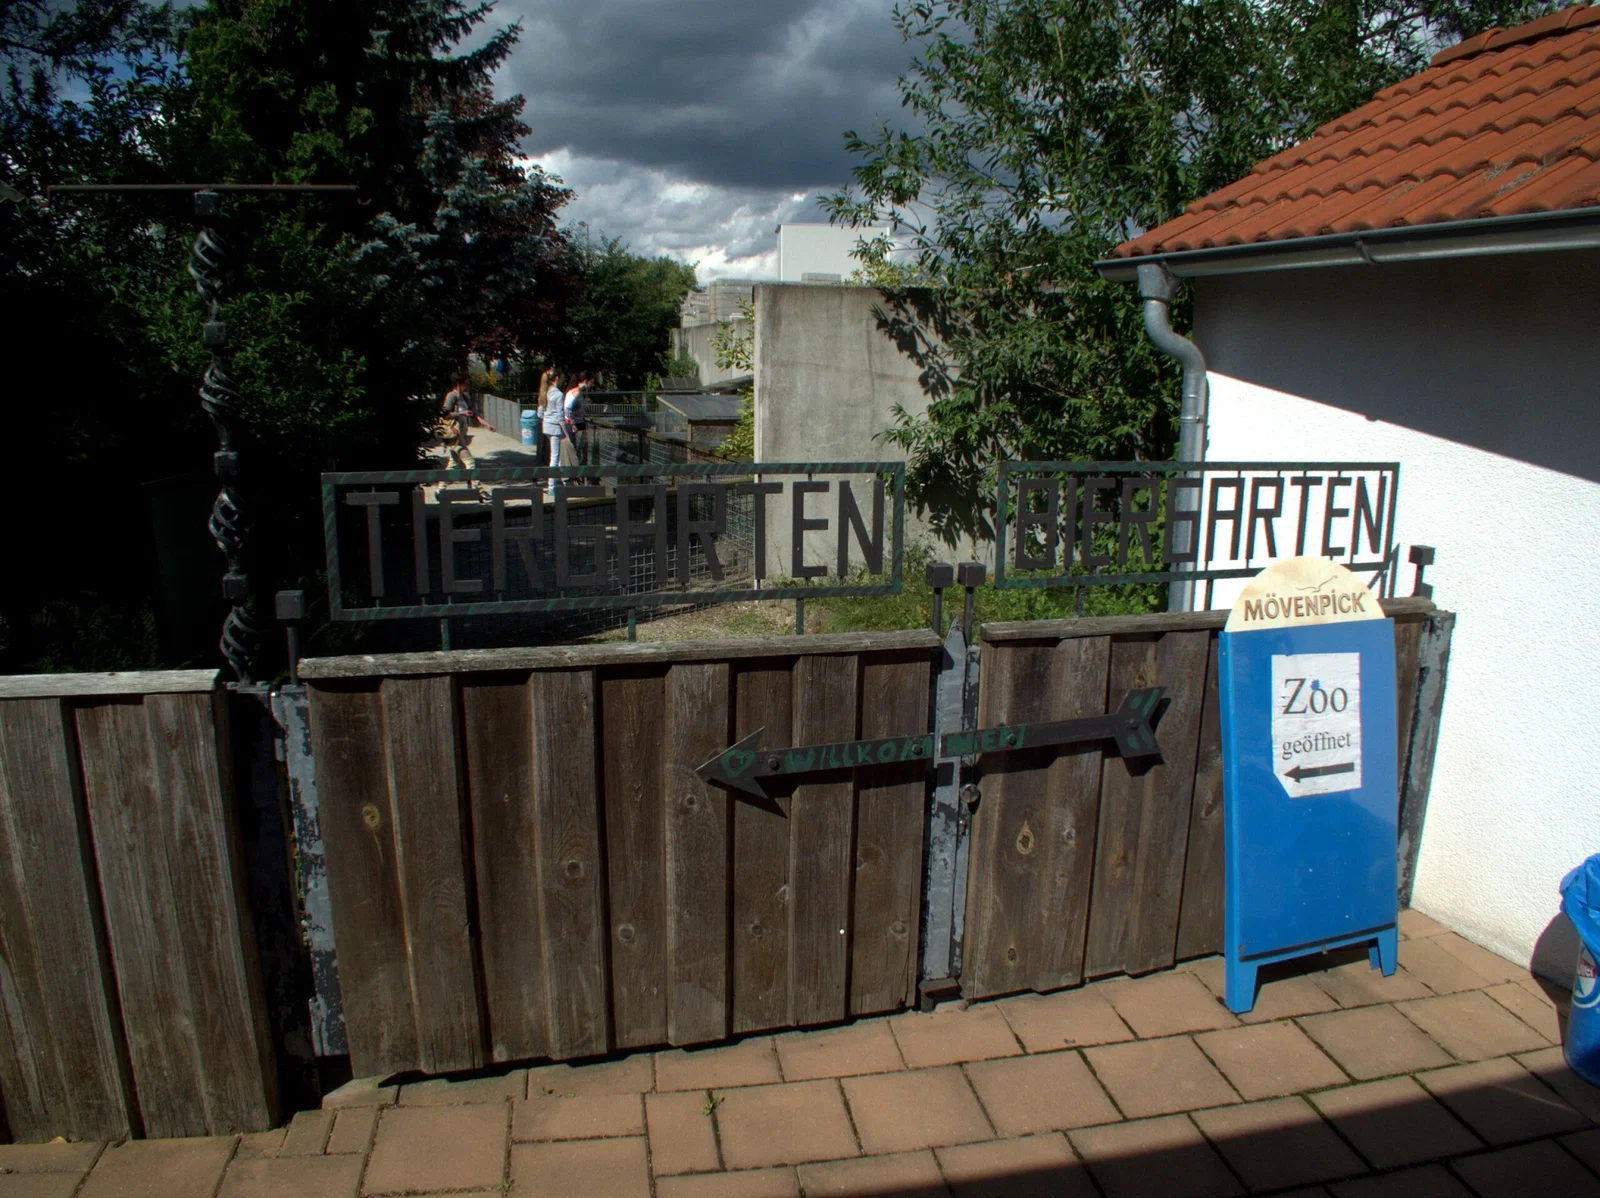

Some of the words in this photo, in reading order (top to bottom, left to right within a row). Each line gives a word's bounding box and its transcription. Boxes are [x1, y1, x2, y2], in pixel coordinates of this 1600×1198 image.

[346, 480, 884, 597] TIERGARTEN
[1015, 476, 1387, 569] BIERGARTEN
[1282, 678, 1348, 715] Zoo
[1282, 731, 1351, 760] geöffnet
